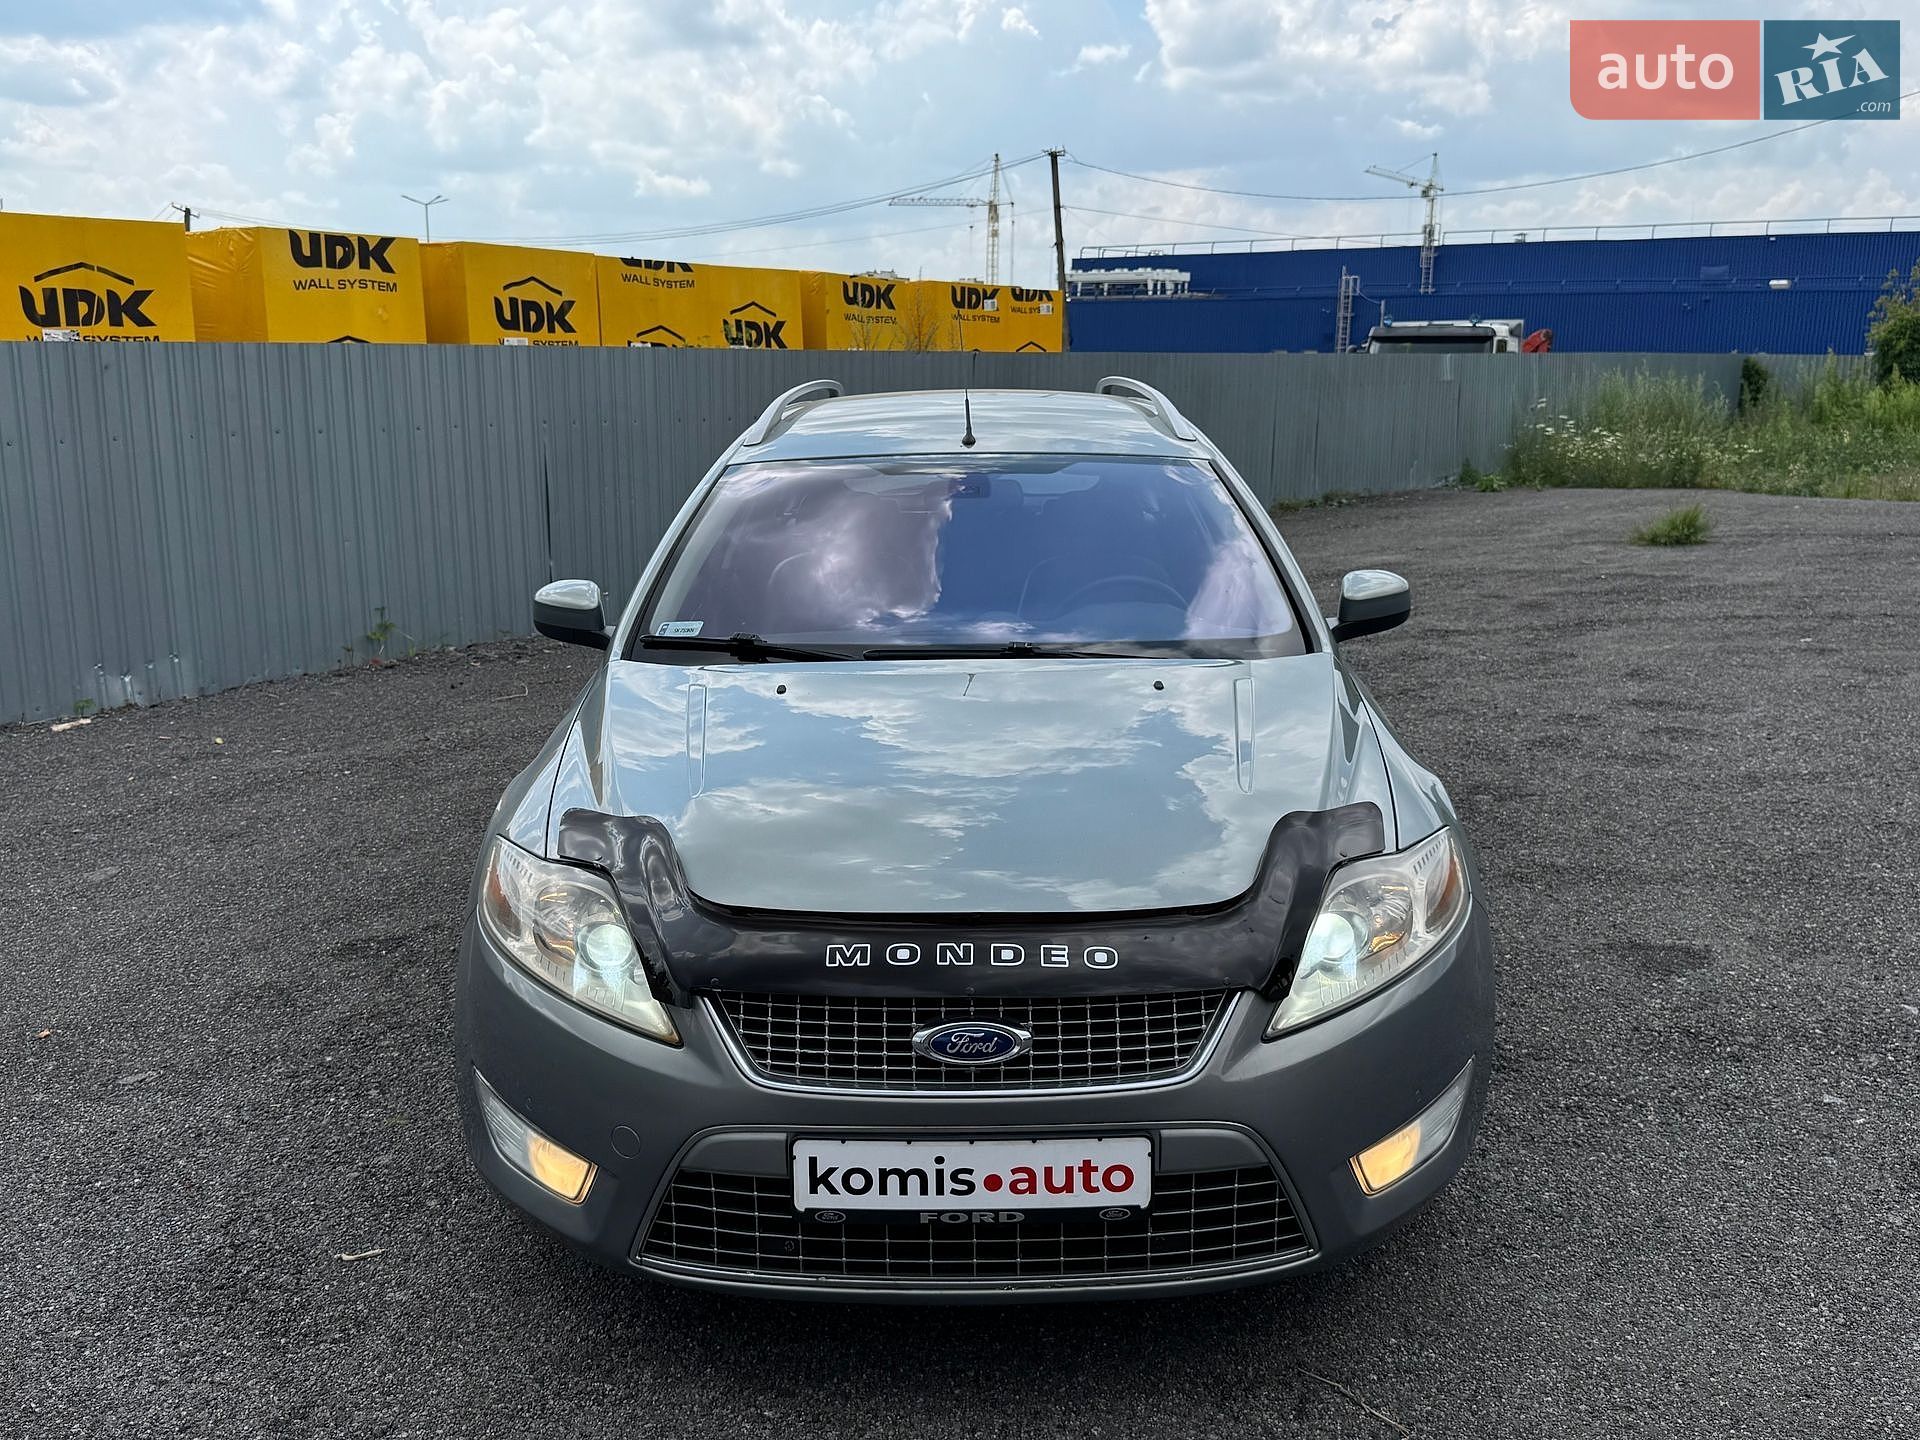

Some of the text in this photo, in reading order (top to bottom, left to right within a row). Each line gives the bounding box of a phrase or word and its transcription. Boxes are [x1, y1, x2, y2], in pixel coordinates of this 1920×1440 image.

[288, 230, 397, 274] UDK
[293, 279, 398, 292] WALL SYSTEM
[621, 273, 695, 289] WALL SYSTEM
[18, 285, 157, 328] UDK
[843, 281, 896, 310] UDK
[493, 296, 577, 334] UDK
[844, 313, 865, 323] WALL
[1011, 306, 1027, 314] WALL
[723, 319, 787, 349] UDK
[826, 943, 1118, 969] MONDEO
[947, 1032, 998, 1053] Ford
[920, 1212, 1025, 1223] FORD
